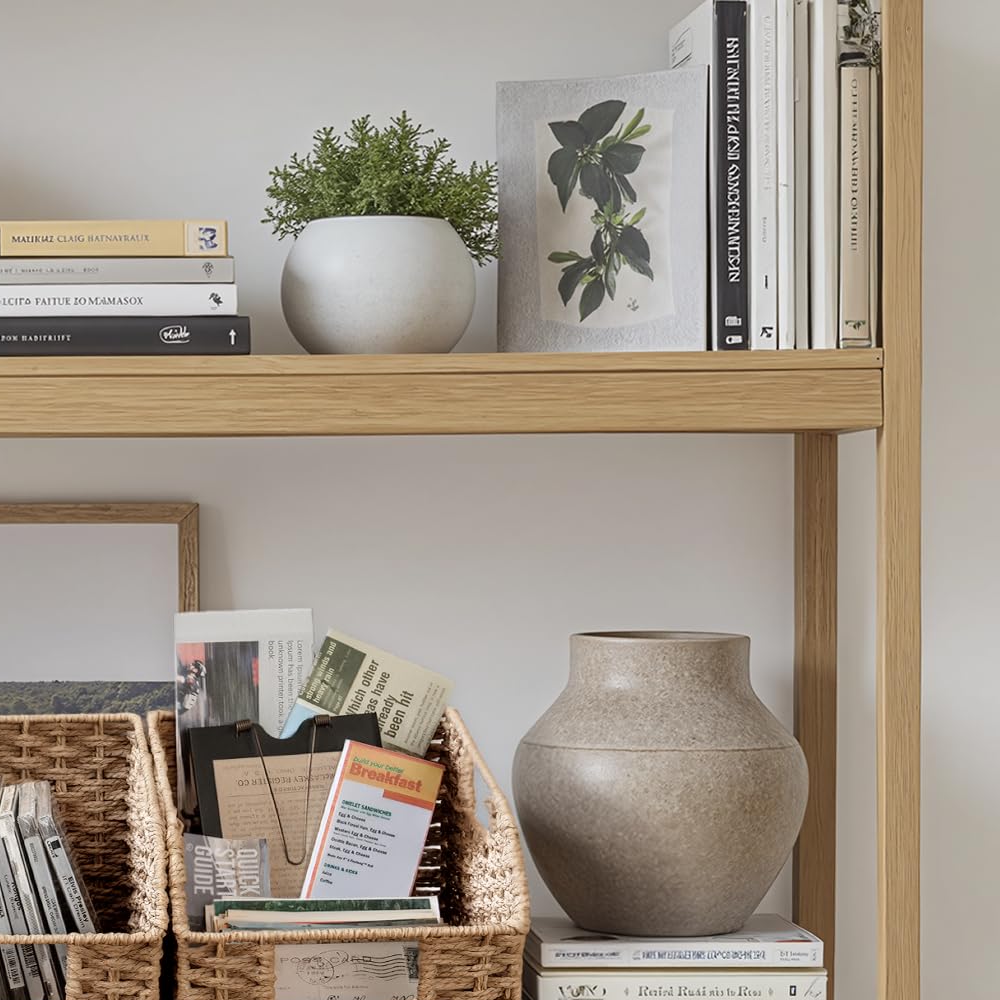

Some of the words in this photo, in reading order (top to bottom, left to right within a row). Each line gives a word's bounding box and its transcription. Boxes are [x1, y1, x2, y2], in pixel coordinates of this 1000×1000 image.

[267, 640, 275, 658] book
[358, 657, 380, 687] other
[370, 669, 391, 697] have
[383, 707, 406, 738] been
[396, 689, 414, 707] hit
[348, 761, 423, 792] Breakfast
[193, 845, 213, 895] GUIDE
[215, 847, 236, 896] START
[236, 848, 260, 894] QUICK
[66, 875, 79, 894] Elvis
[73, 895, 90, 923] Presley
